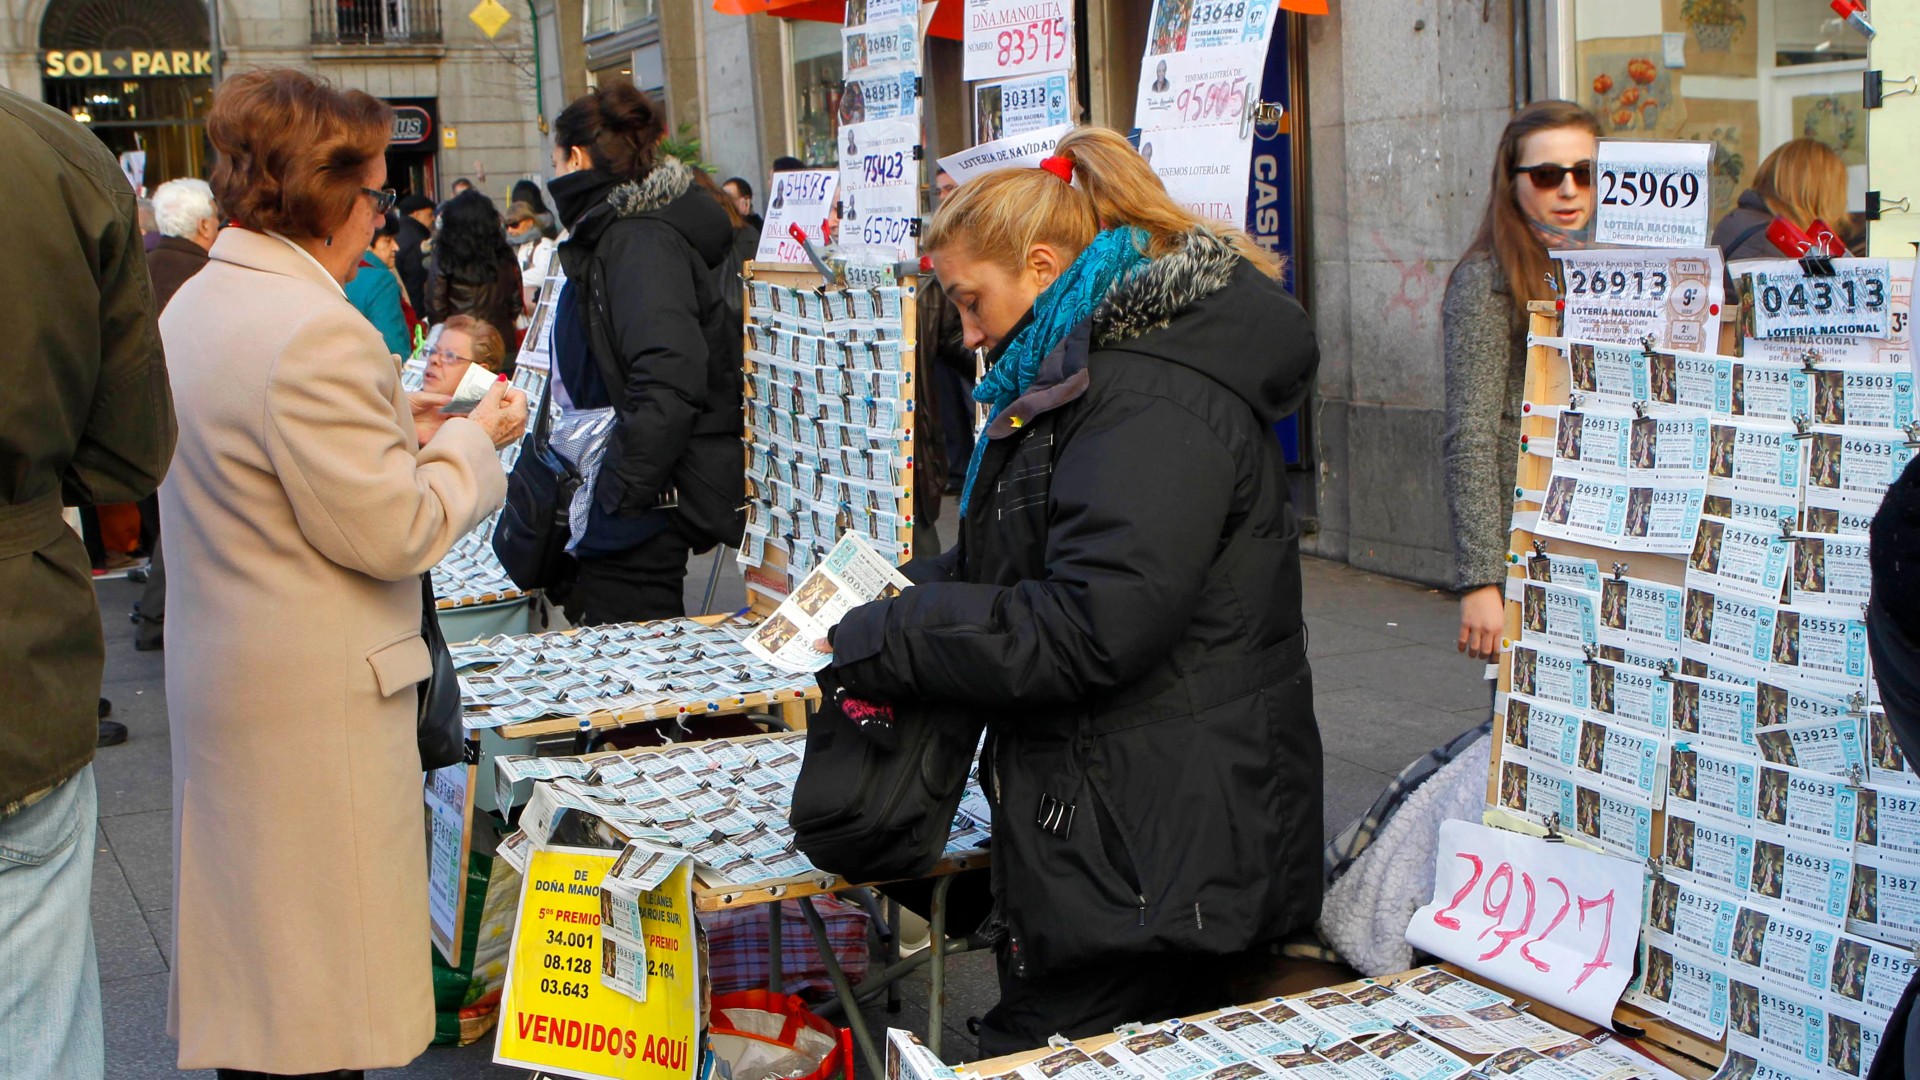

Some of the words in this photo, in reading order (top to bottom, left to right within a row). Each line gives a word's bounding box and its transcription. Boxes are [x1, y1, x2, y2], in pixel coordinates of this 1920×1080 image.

[1192, 2, 1245, 22] 43648
[868, 34, 898, 52] 26487
[968, 41, 993, 53] NÚMERO
[997, 17, 1068, 67] 83595
[46, 51, 109, 77] SOL
[131, 51, 212, 76] PARK
[865, 82, 900, 102] 48913
[1003, 87, 1046, 109] 30313
[1177, 76, 1247, 123] 95005
[998, 149, 1008, 161] DE
[863, 151, 903, 184] 75423
[1158, 167, 1188, 177] TENEMOS
[1189, 163, 1220, 175] LOTERÍA
[1221, 165, 1230, 175] DE
[786, 173, 832, 200] 54575
[1601, 170, 1699, 208] 25969
[864, 215, 910, 244] 65707
[1604, 219, 1644, 231] LOTERÍA
[1647, 223, 1698, 235] NACIONAL
[1637, 234, 1653, 243] parte
[1655, 234, 1665, 242] del
[1666, 235, 1687, 245] billete
[1682, 263, 1697, 272] 2/11
[1572, 270, 1667, 296] 26913
[1763, 279, 1884, 313] 04313
[1571, 307, 1610, 316] LOTERÍA
[1611, 308, 1658, 318] NACIONAL
[1627, 319, 1648, 327] billete
[1767, 325, 1815, 337] LOTERÍA
[1820, 324, 1880, 335] NACIONAL
[1800, 336, 1859, 346] NACIONAL
[1596, 351, 1631, 363] 65126
[1822, 347, 1847, 355] billete
[1677, 360, 1715, 374] 65126
[1746, 370, 1789, 383] 73134
[1846, 375, 1893, 387] 25803
[1584, 418, 1620, 431] 26913
[1658, 423, 1693, 434] 04313
[1738, 433, 1780, 446] 33104
[1844, 440, 1891, 455] 46633
[1576, 483, 1613, 498] 26913
[1654, 492, 1688, 503] 04313
[1734, 504, 1778, 519] 33104
[1725, 529, 1769, 548] 54764
[1552, 563, 1585, 576] 32344
[1629, 586, 1665, 603] 78585
[1716, 600, 1757, 619] 54764
[1802, 618, 1846, 634] 45552
[1538, 655, 1572, 670] 45269
[1615, 674, 1652, 688] 45269
[1701, 689, 1740, 705] 45552
[1531, 709, 1564, 726] 75277
[1607, 732, 1642, 749] 75277
[1792, 728, 1838, 743] 43923
[1698, 759, 1736, 776] 00141
[1530, 772, 1561, 789] 75277
[1790, 779, 1835, 797] 46633
[1602, 798, 1635, 816] 75277
[1881, 797, 1920, 812] 1387
[1697, 828, 1735, 847] 00141
[1839, 825, 1848, 833] 20
[1786, 853, 1830, 872] 46633
[574, 870, 588, 881] DE
[535, 880, 565, 893] DOÑA
[1680, 891, 1719, 914] 69132
[1433, 852, 1615, 994] 29327
[546, 930, 593, 949] 34.001
[1769, 921, 1812, 943] 81592
[650, 936, 678, 951] PREMIO
[544, 954, 592, 974] 08.128
[1674, 961, 1711, 983] 69132
[541, 978, 589, 999] 03.643
[1761, 995, 1804, 1018] 81592
[518, 1012, 637, 1059] VENDIDOS
[642, 1034, 688, 1072] AQUÍ
[1202, 1036, 1233, 1054] 67809
[1170, 1044, 1202, 1063] 56129
[1413, 1043, 1448, 1064] 93118
